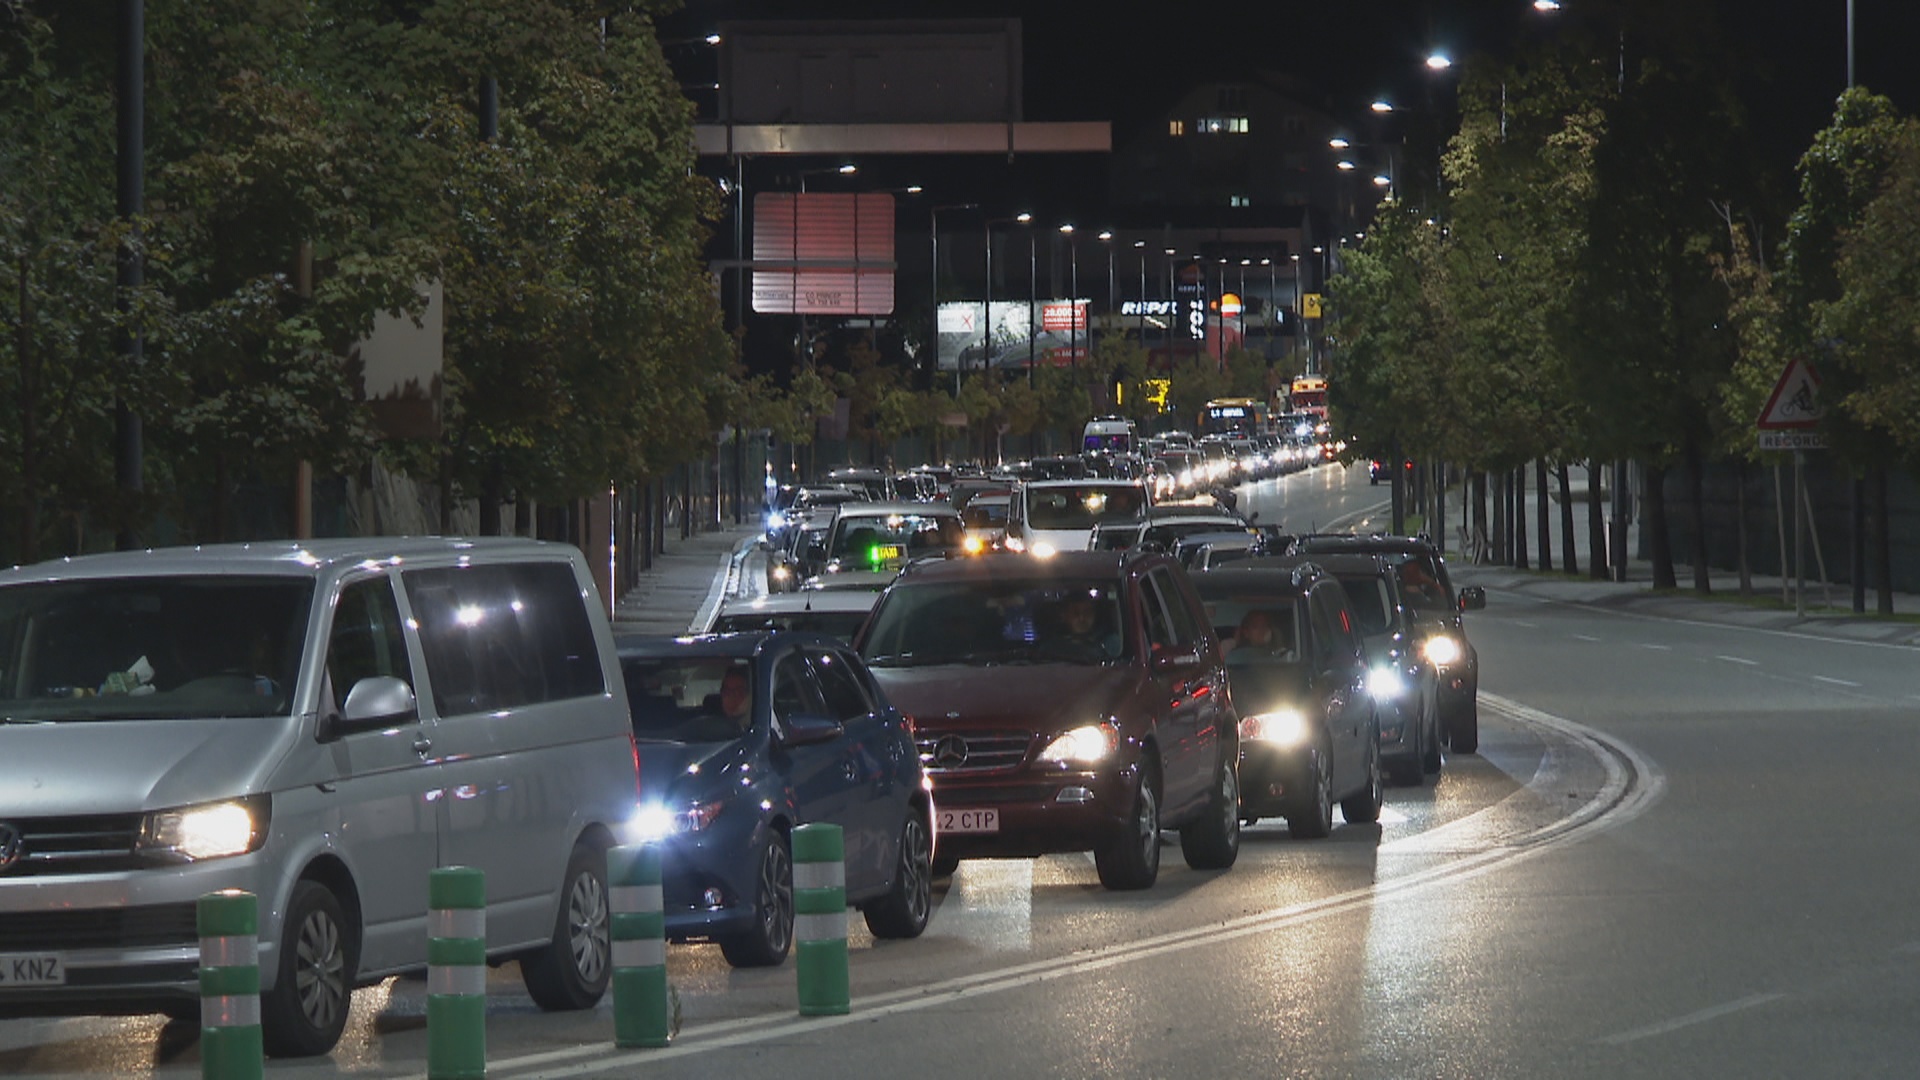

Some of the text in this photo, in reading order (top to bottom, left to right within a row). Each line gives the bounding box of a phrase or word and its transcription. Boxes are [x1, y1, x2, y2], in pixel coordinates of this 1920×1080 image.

[1764, 435, 1832, 447] RECORD
[961, 811, 994, 829] CTP
[13, 957, 59, 981] KNZ
